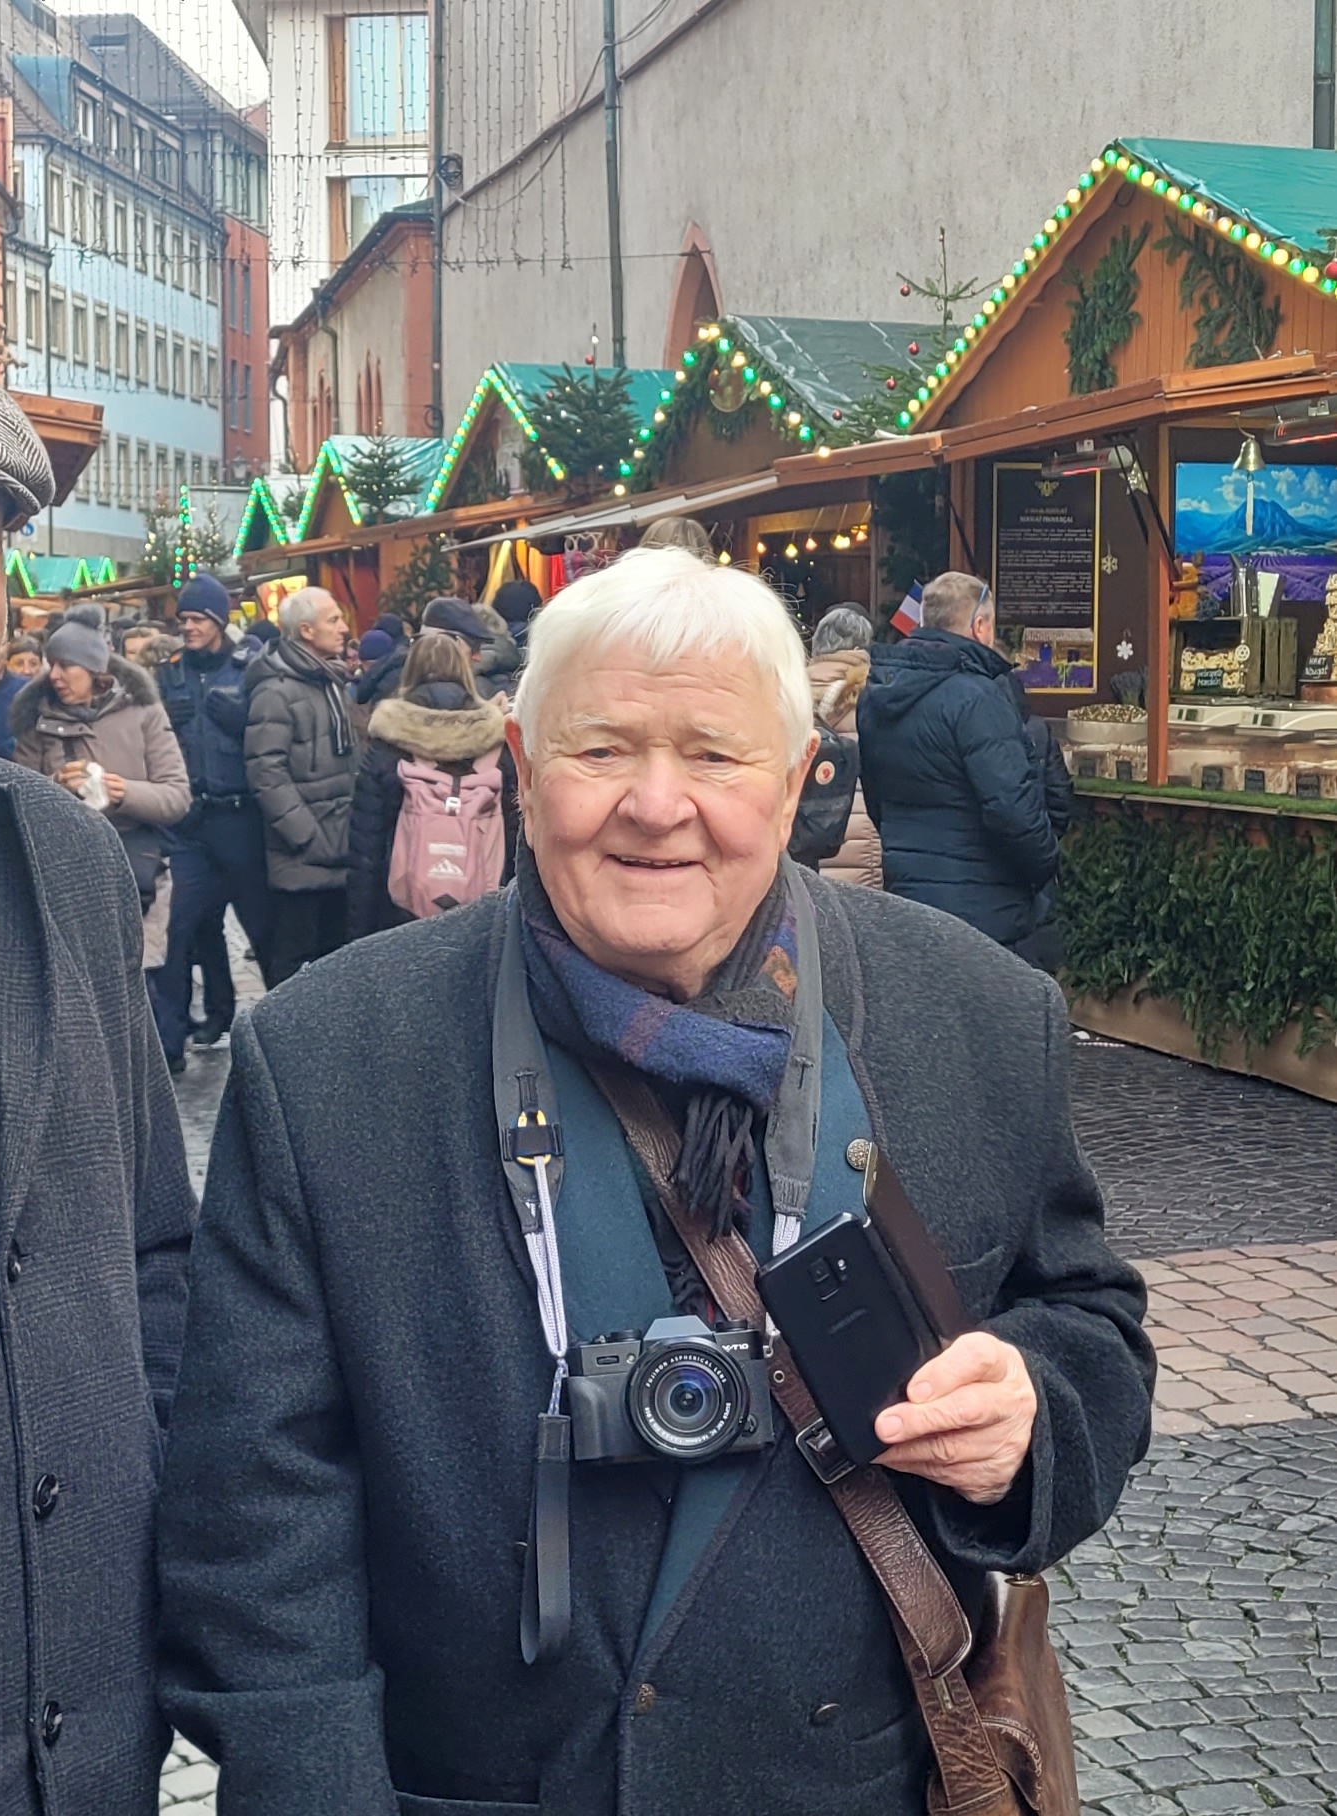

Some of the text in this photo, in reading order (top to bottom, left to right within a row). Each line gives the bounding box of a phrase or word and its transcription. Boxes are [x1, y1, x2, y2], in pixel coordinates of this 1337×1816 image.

[646, 1355, 727, 1388] FUJINON ASPHERICAL LENS
